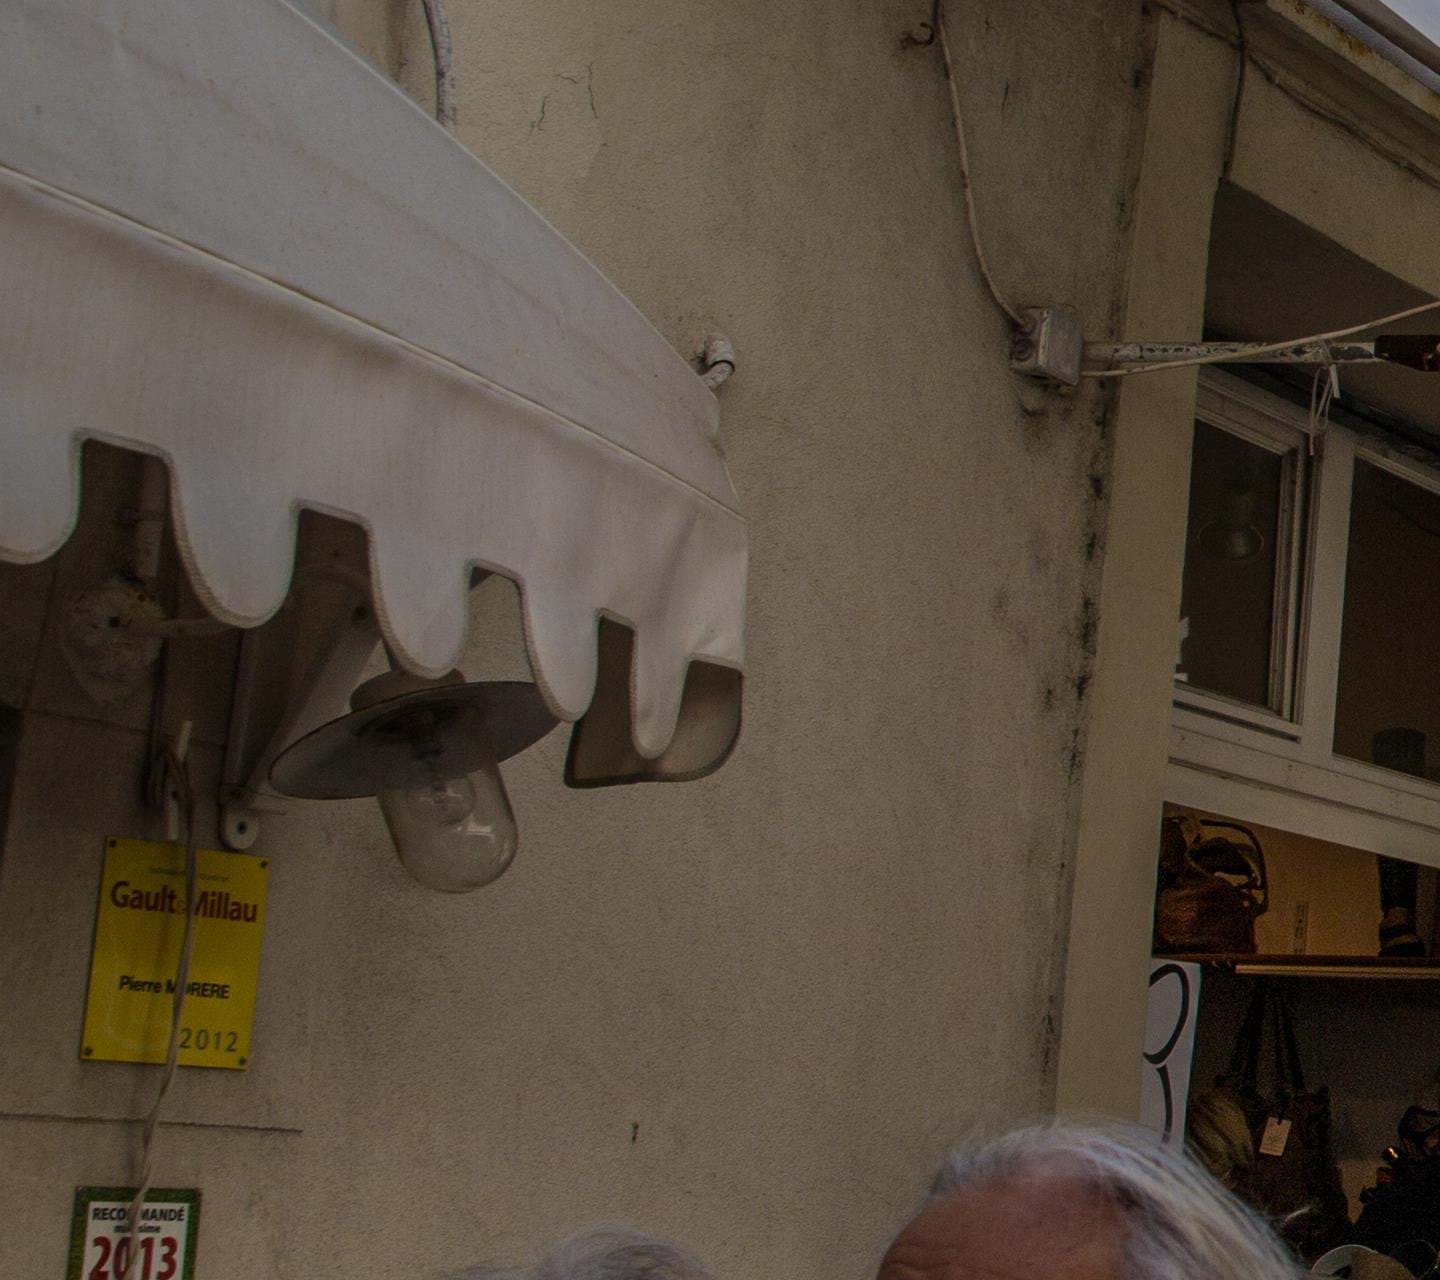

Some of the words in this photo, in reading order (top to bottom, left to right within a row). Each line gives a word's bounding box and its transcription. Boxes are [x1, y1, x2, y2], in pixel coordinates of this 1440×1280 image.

[118, 975, 162, 994] Pierre
[178, 1027, 239, 1053] 2012
[92, 1206, 186, 1222] RECOMANDÉ
